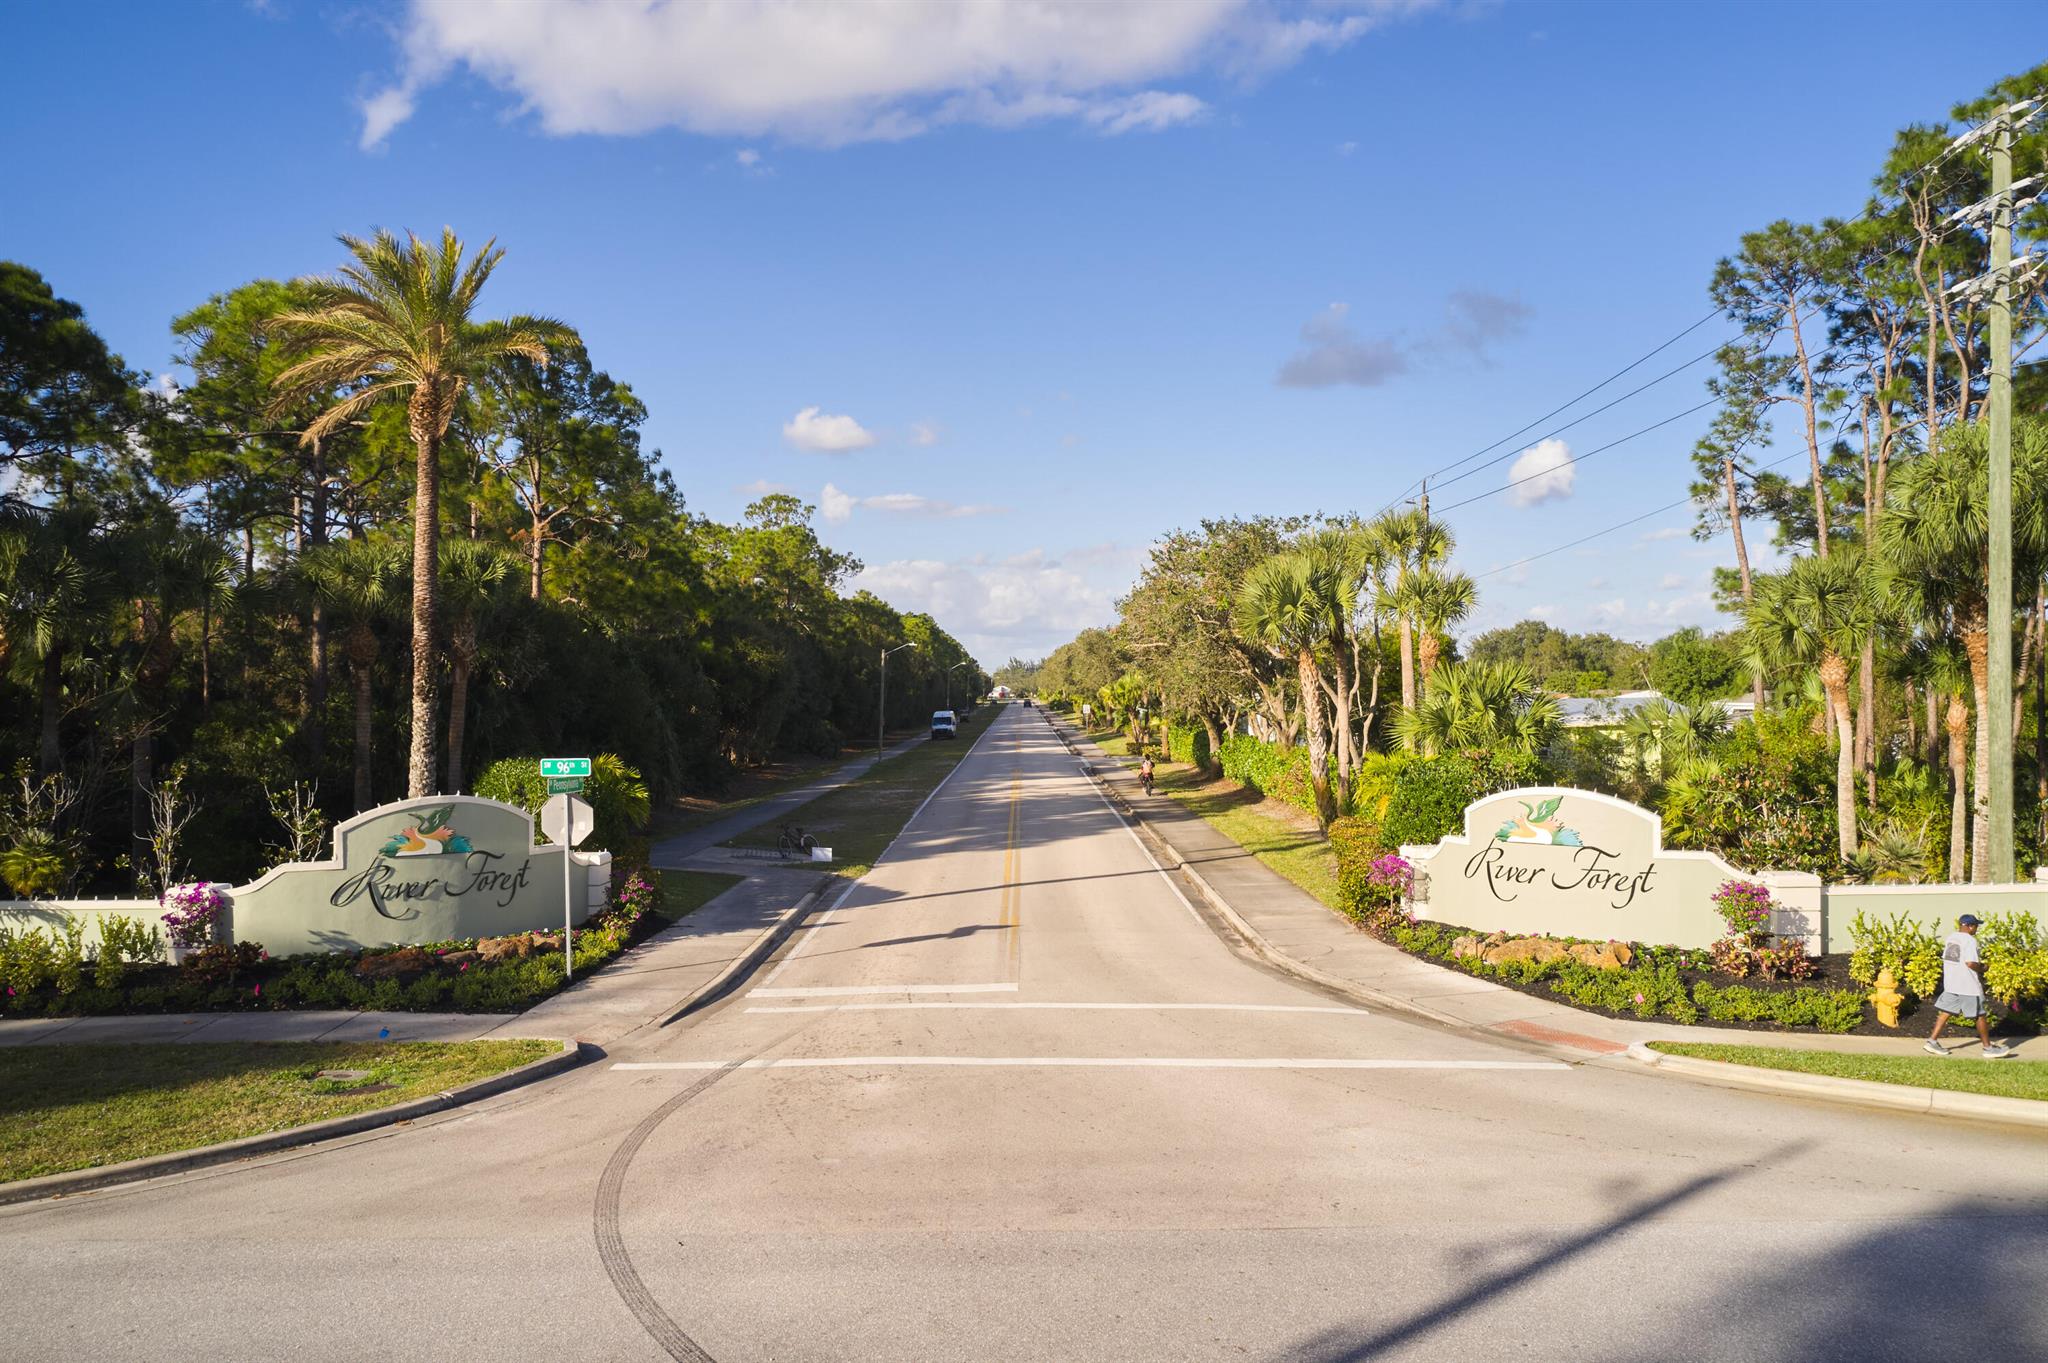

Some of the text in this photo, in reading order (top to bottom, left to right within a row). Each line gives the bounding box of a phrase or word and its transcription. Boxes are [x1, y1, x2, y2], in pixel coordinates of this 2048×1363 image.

[556, 761, 575, 773] 96th
[330, 850, 530, 920] River Forest
[1464, 838, 1657, 909] River Forest
